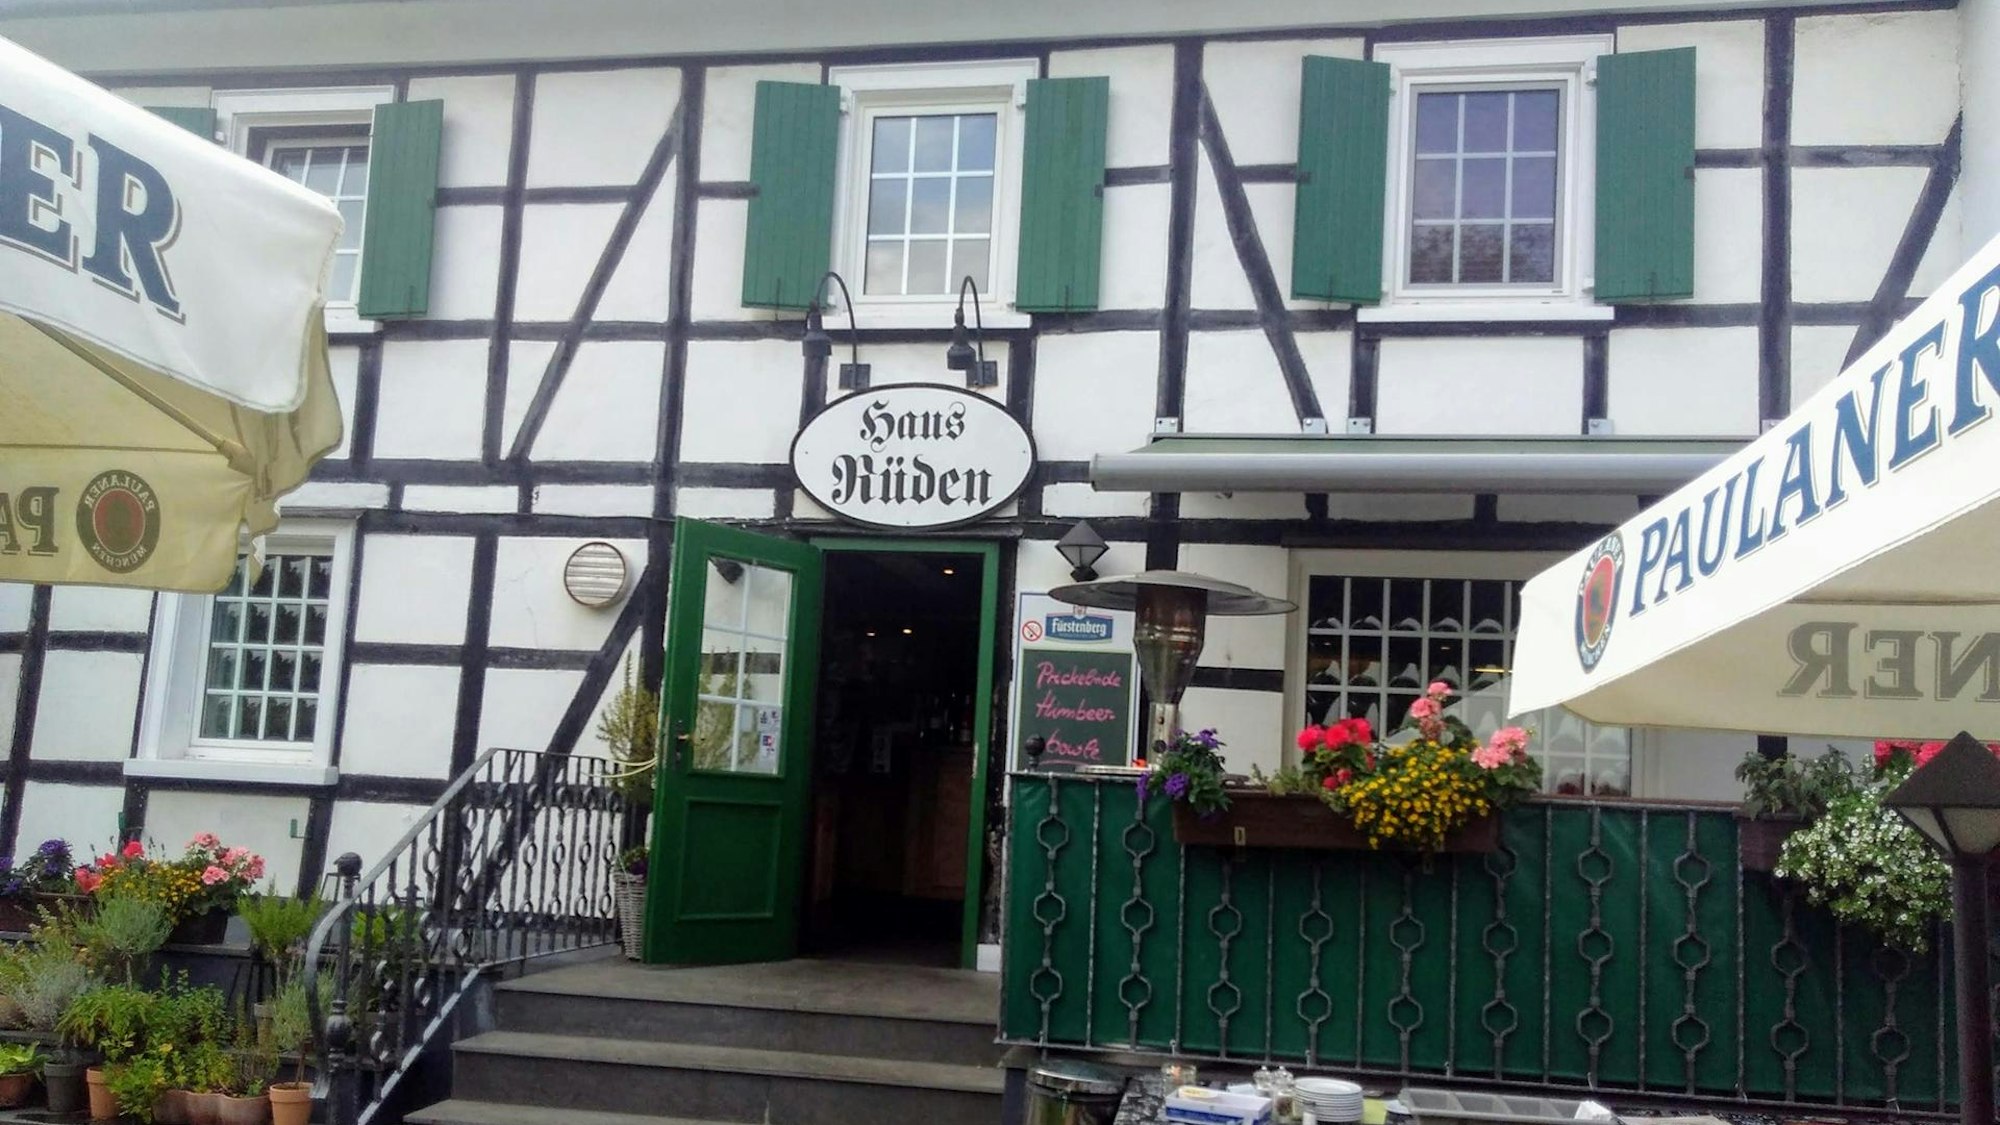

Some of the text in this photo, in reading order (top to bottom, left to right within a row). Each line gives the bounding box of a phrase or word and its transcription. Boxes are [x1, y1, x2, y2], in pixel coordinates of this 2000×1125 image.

[860, 400, 966, 453] Haus
[1629, 262, 2000, 618] PAULANER
[832, 454, 993, 506] Rüden
[1052, 618, 1107, 636] Fürstenberg
